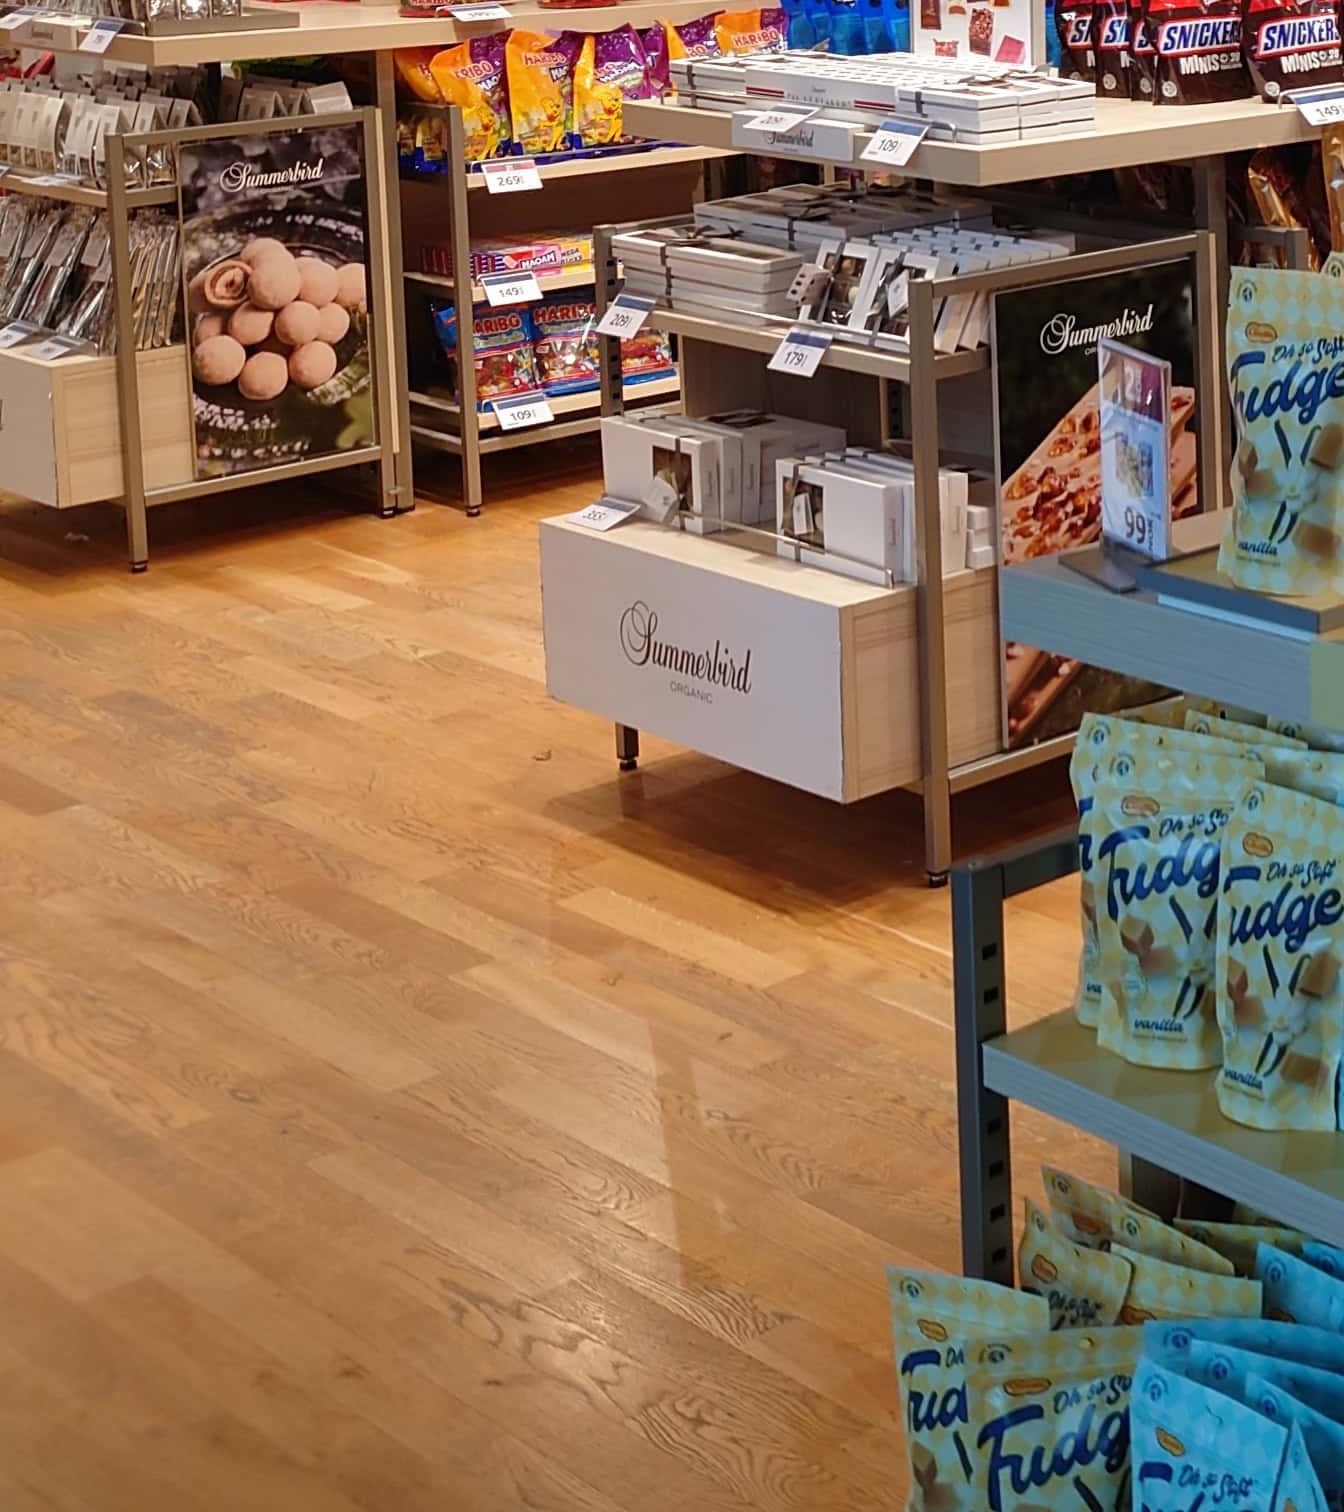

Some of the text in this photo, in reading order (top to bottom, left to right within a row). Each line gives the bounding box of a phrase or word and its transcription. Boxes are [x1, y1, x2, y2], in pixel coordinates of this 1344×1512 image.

[734, 28, 778, 47] HARIBO
[1180, 56, 1220, 74] MINIS
[1282, 54, 1319, 74] MINIS
[1316, 106, 1339, 118] 149
[879, 137, 898, 152] 109
[220, 158, 324, 193] Summerbird
[497, 175, 520, 187] 269
[521, 251, 556, 269] MAOAM
[499, 287, 519, 298] 149
[610, 314, 626, 327] 209
[1040, 304, 1154, 355] Summerbird
[785, 350, 803, 366] 179
[1273, 336, 1344, 363] Oh so Soft
[510, 410, 531, 422] 109
[620, 600, 752, 694] Summerbird
[670, 680, 713, 704] ORGANIC
[1133, 1018, 1184, 1033] vanilla
[1224, 1069, 1263, 1090] vanilla
